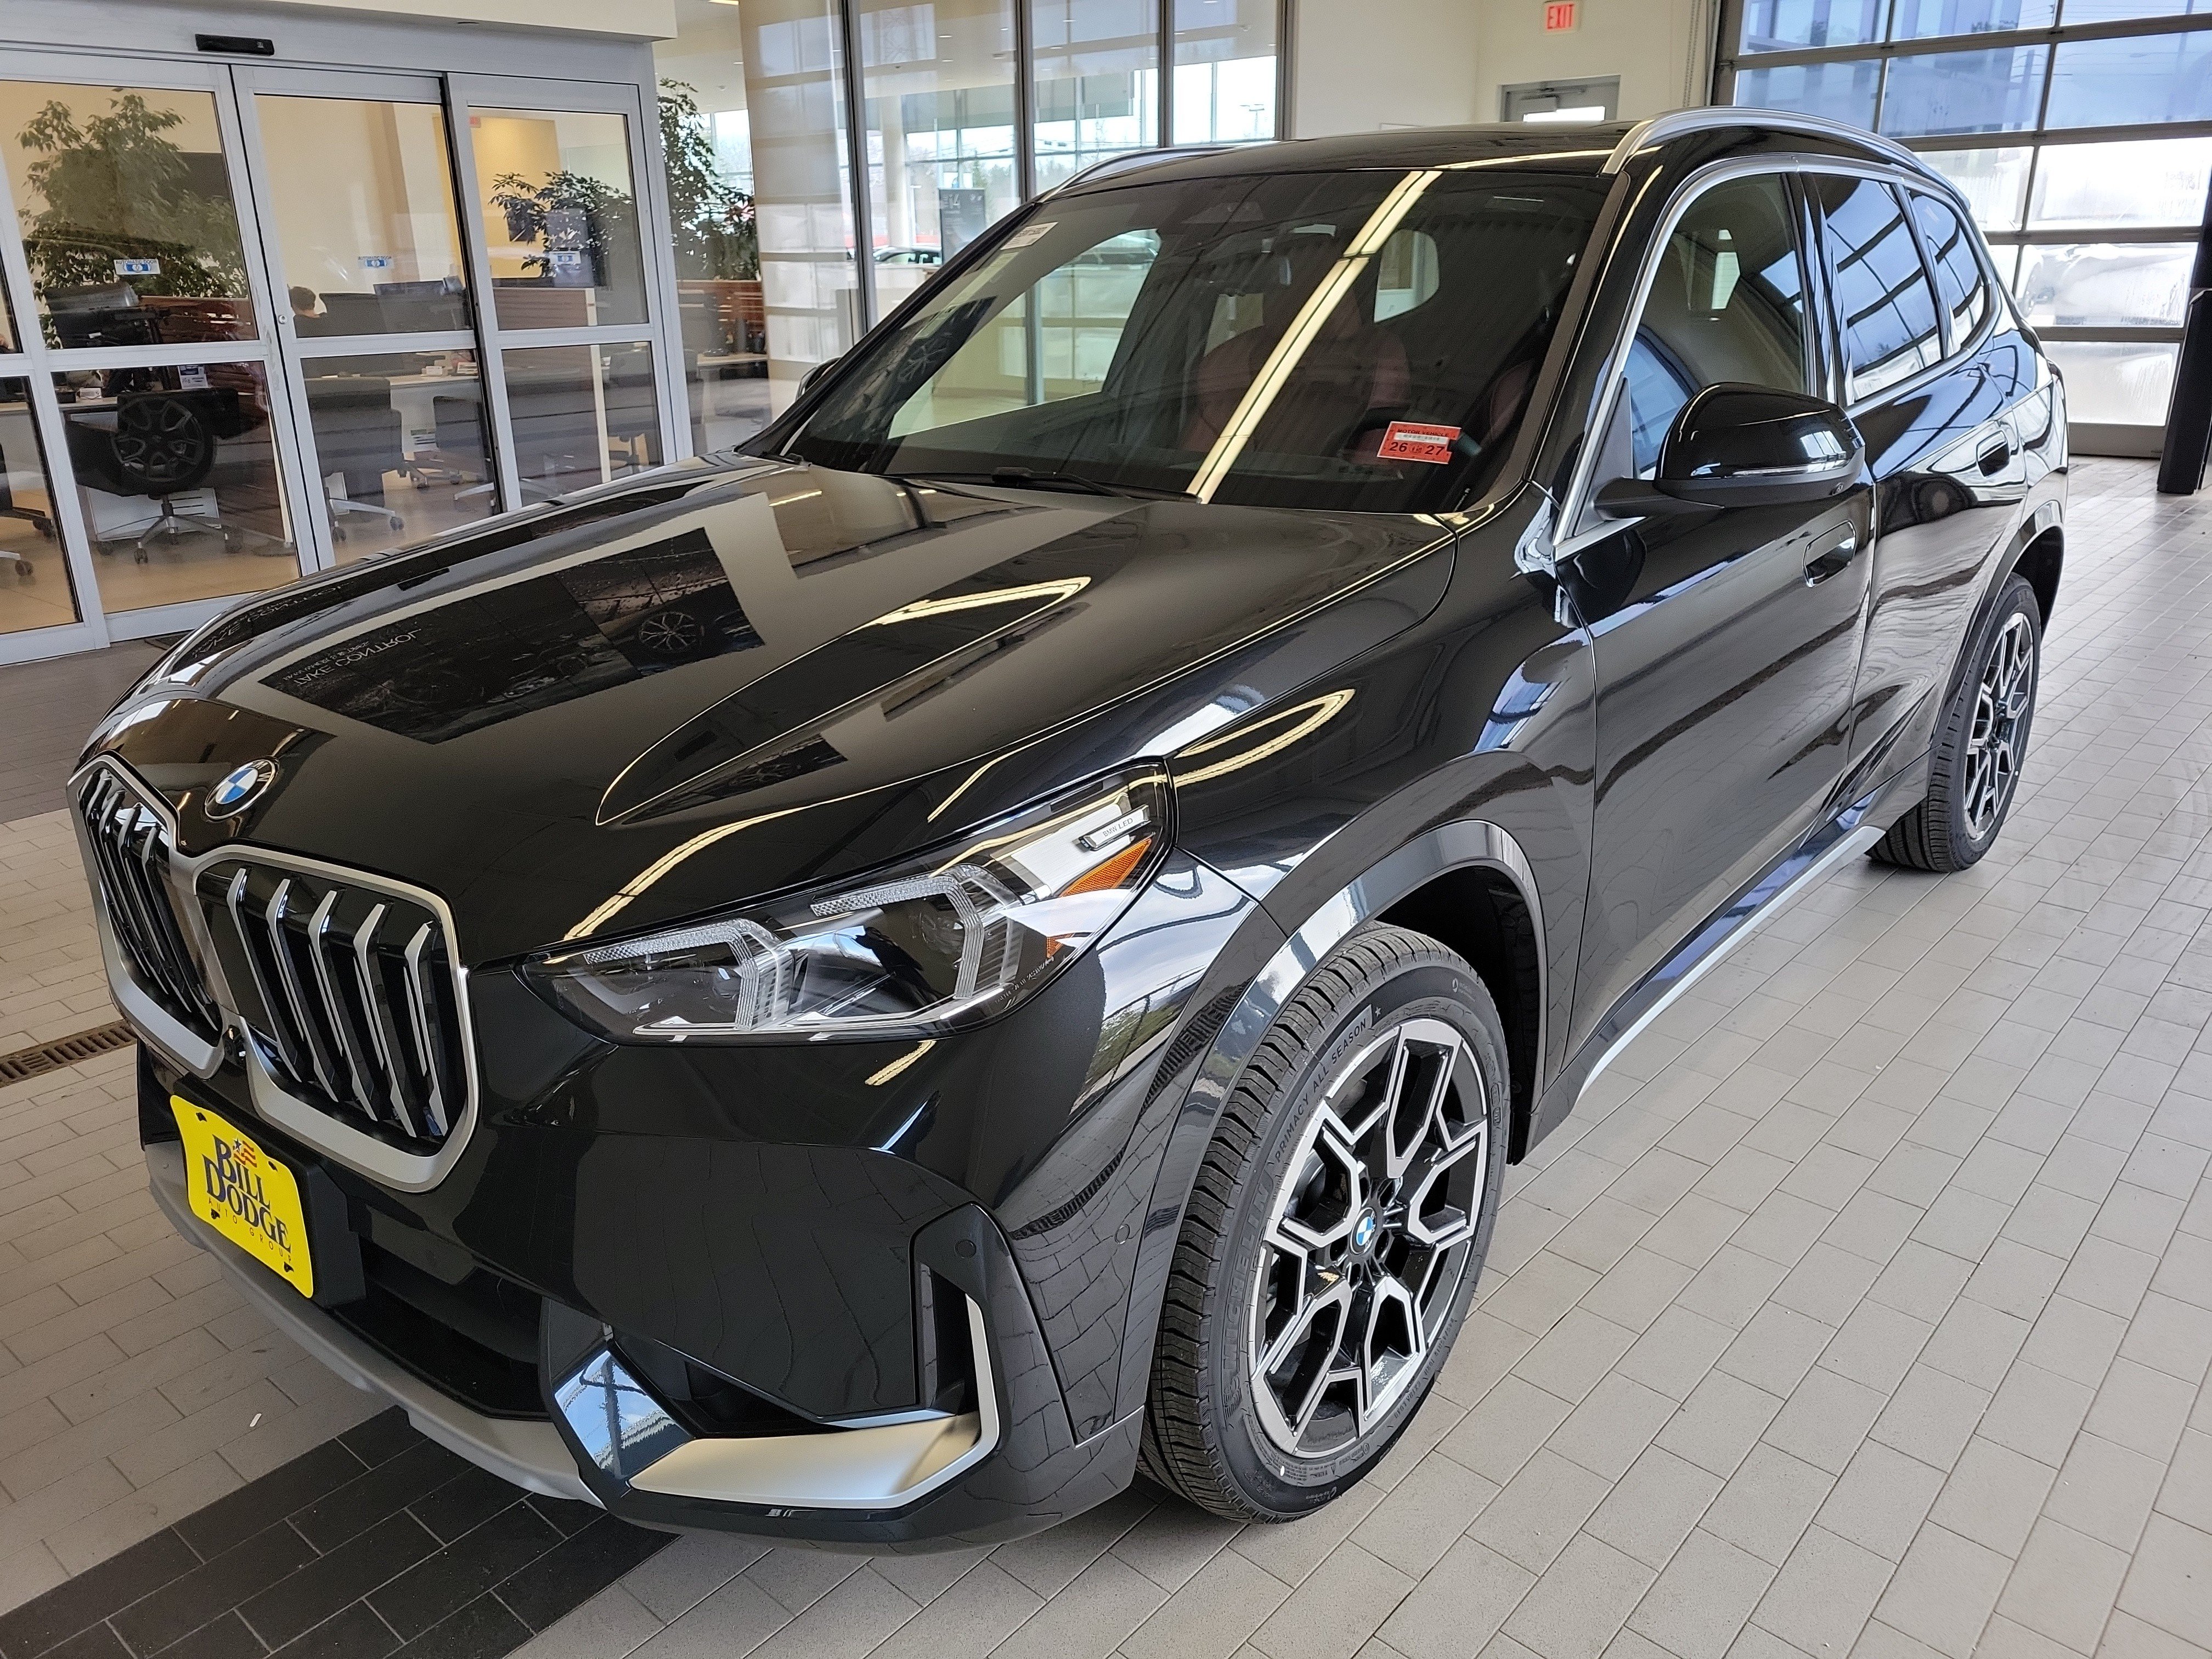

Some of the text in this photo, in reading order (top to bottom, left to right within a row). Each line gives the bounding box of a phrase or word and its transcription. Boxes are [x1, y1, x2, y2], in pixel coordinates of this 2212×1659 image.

[1548, 4, 1574, 29] EXIT
[1389, 442, 1446, 455] 26 27
[1103, 818, 1133, 837] BMW LED
[1275, 1018, 1367, 1163] PRIMACY ALL SEASON
[202, 1153, 291, 1254] DODGE
[212, 1134, 270, 1211] BILL
[208, 1197, 291, 1263] AUTO GROUP
[1223, 1182, 1269, 1369] MICHELIN
[1394, 1381, 1421, 1419] EXTRA LOAD
